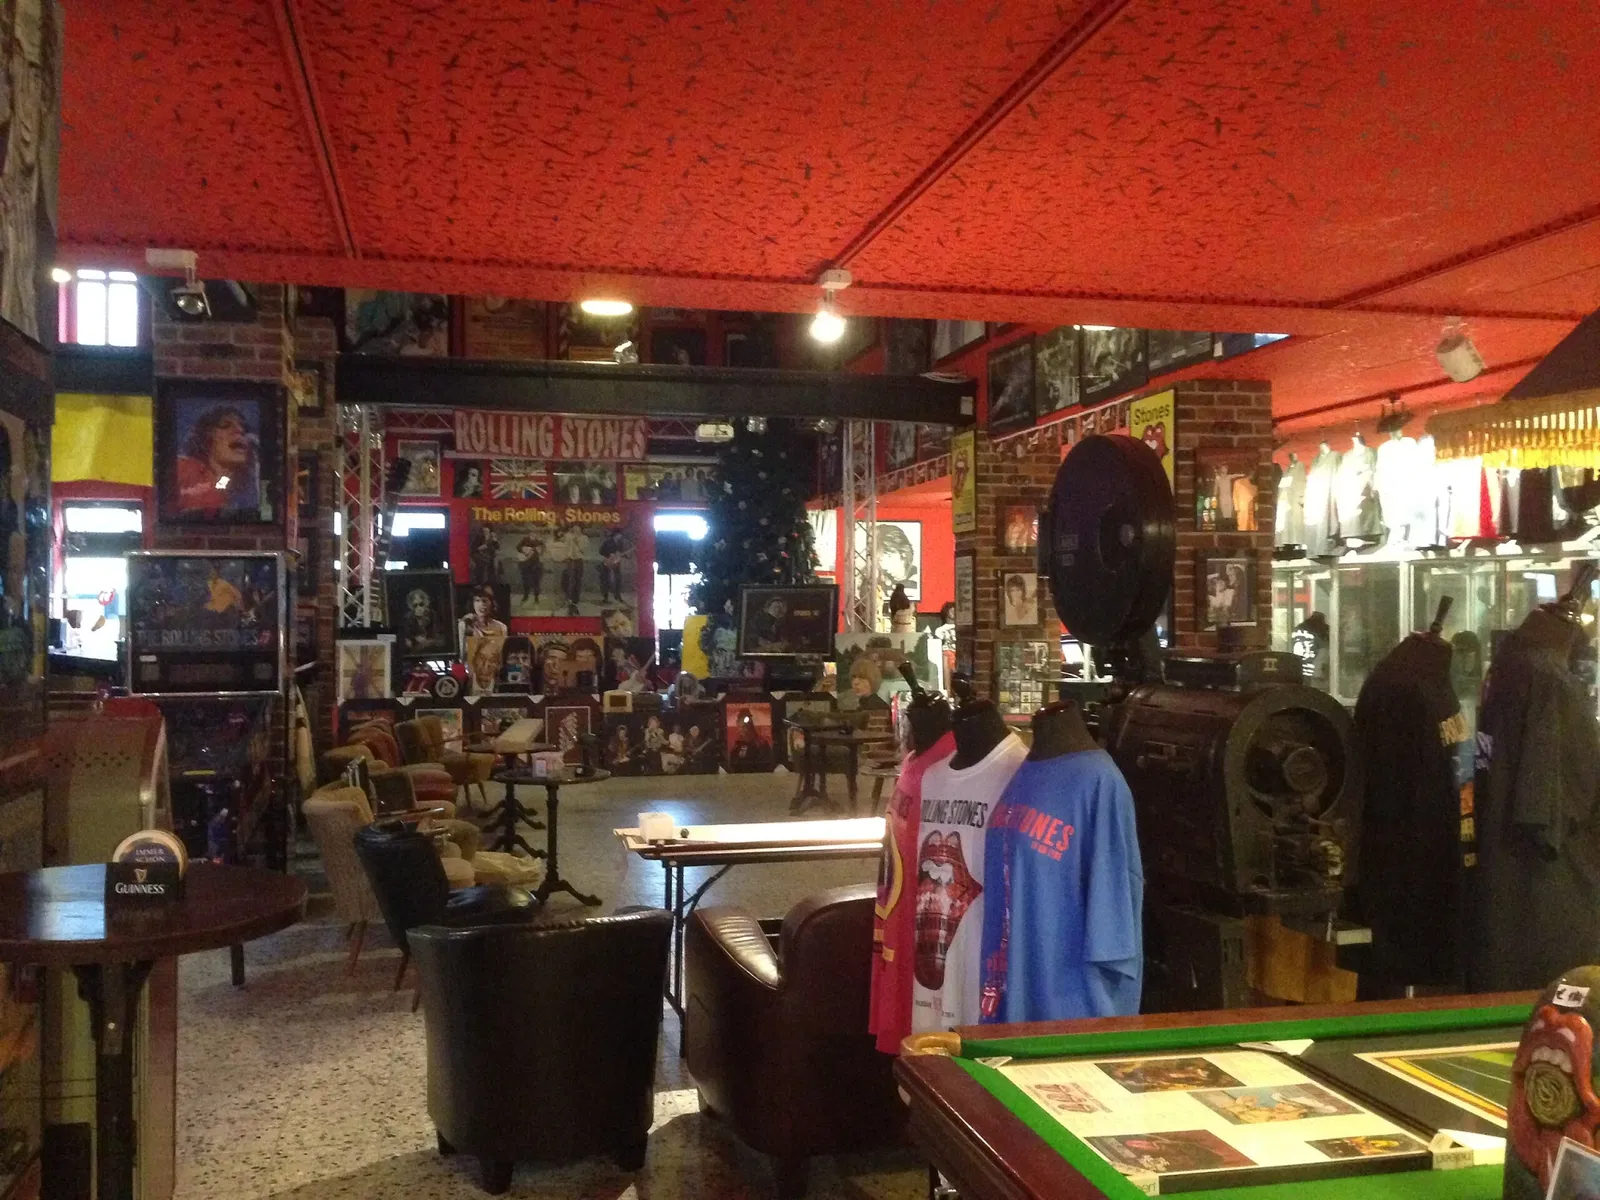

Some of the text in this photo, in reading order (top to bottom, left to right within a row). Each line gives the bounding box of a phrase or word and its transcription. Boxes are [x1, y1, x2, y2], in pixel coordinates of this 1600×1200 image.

[1135, 403, 1170, 426] Stones
[455, 411, 646, 459] ROLLING STONES
[472, 507, 621, 526] The Rolling Stones
[947, 800, 988, 828] STONES
[114, 882, 165, 894] GUINNESS
